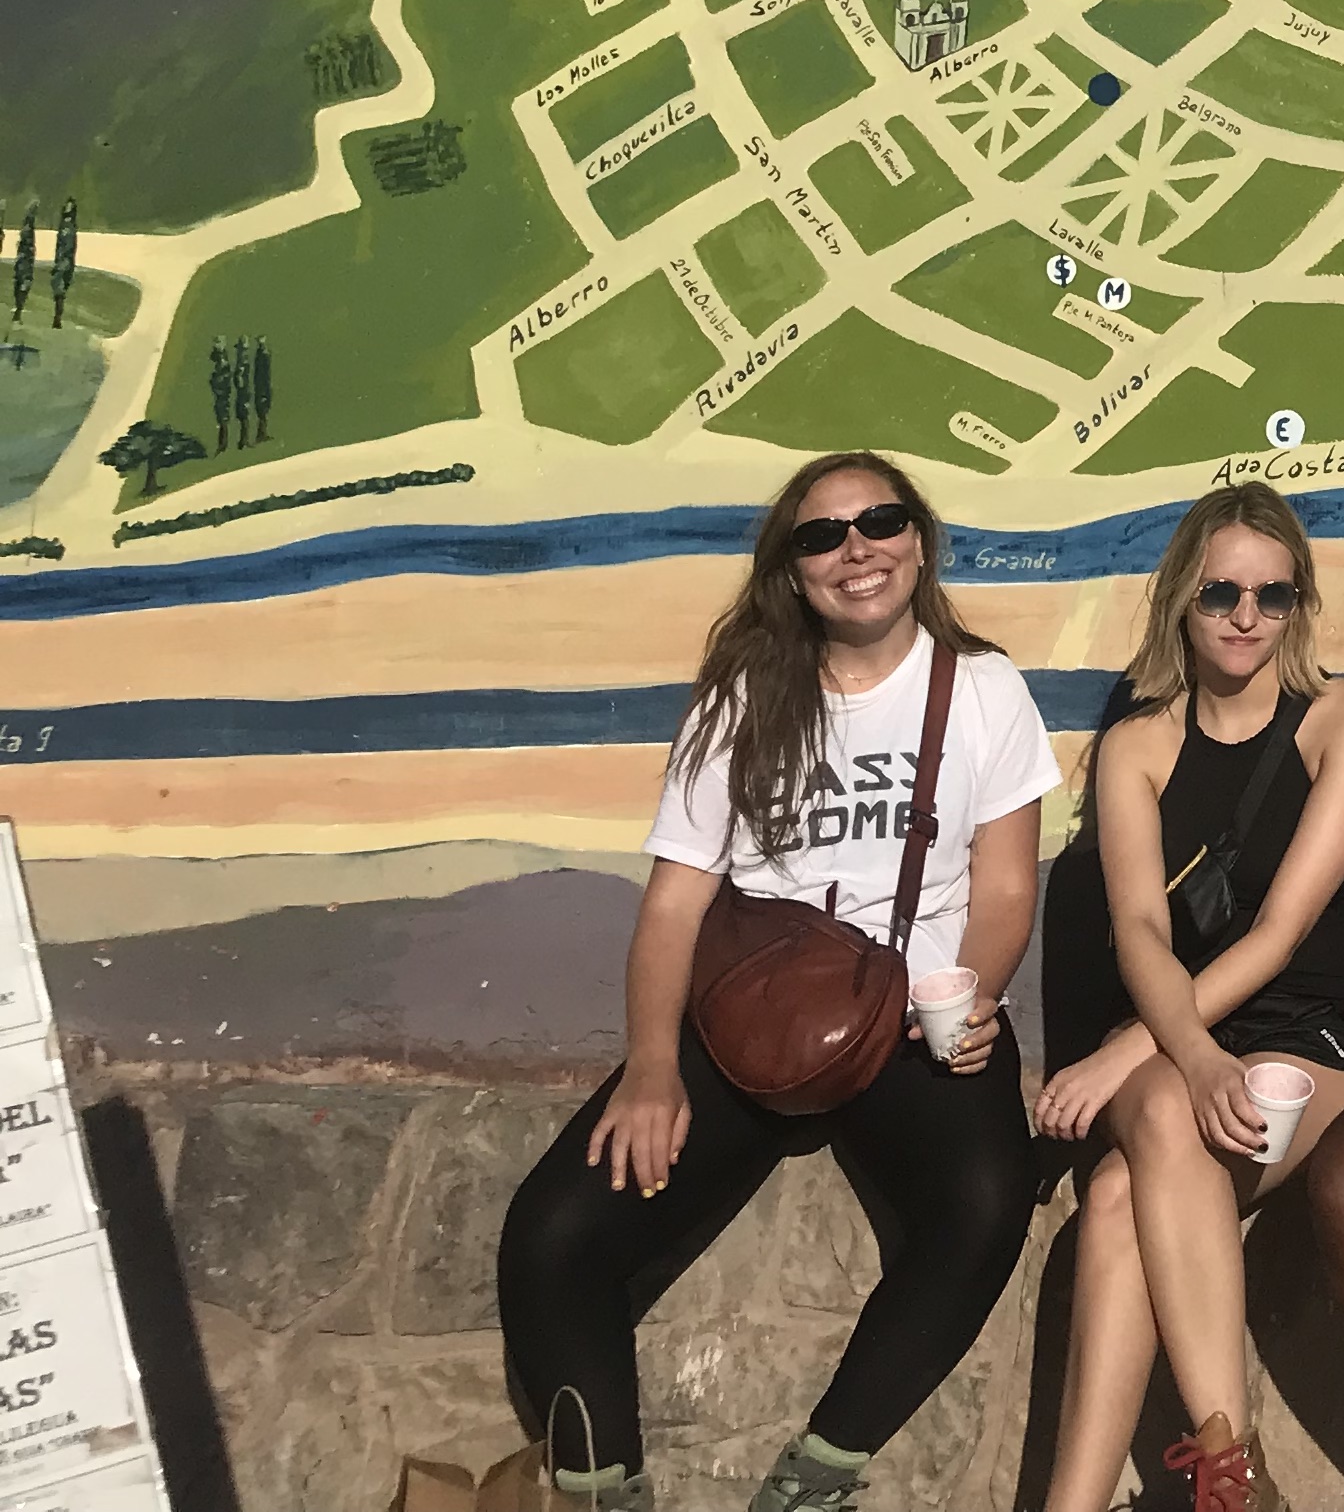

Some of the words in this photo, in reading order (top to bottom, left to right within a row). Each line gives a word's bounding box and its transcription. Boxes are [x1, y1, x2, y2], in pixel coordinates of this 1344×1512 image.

[1283, 12, 1332, 46] Jujuy
[536, 84, 565, 108] Los
[569, 47, 621, 86] Molles
[585, 99, 696, 181] Choquevilca
[1177, 94, 1243, 137] Belgrano
[743, 136, 782, 183] San
[785, 187, 843, 256] Martin
[1048, 218, 1105, 263] Lavalle
[670, 257, 688, 277] 21
[679, 275, 699, 298] de
[1104, 281, 1126, 305] M
[507, 275, 610, 353] Alberro
[695, 321, 801, 418] Rivadavia
[1072, 363, 1152, 445] Bolivar
[972, 422, 1007, 451] Fierro
[974, 547, 1057, 571] Grande
[772, 752, 946, 805] ASY
